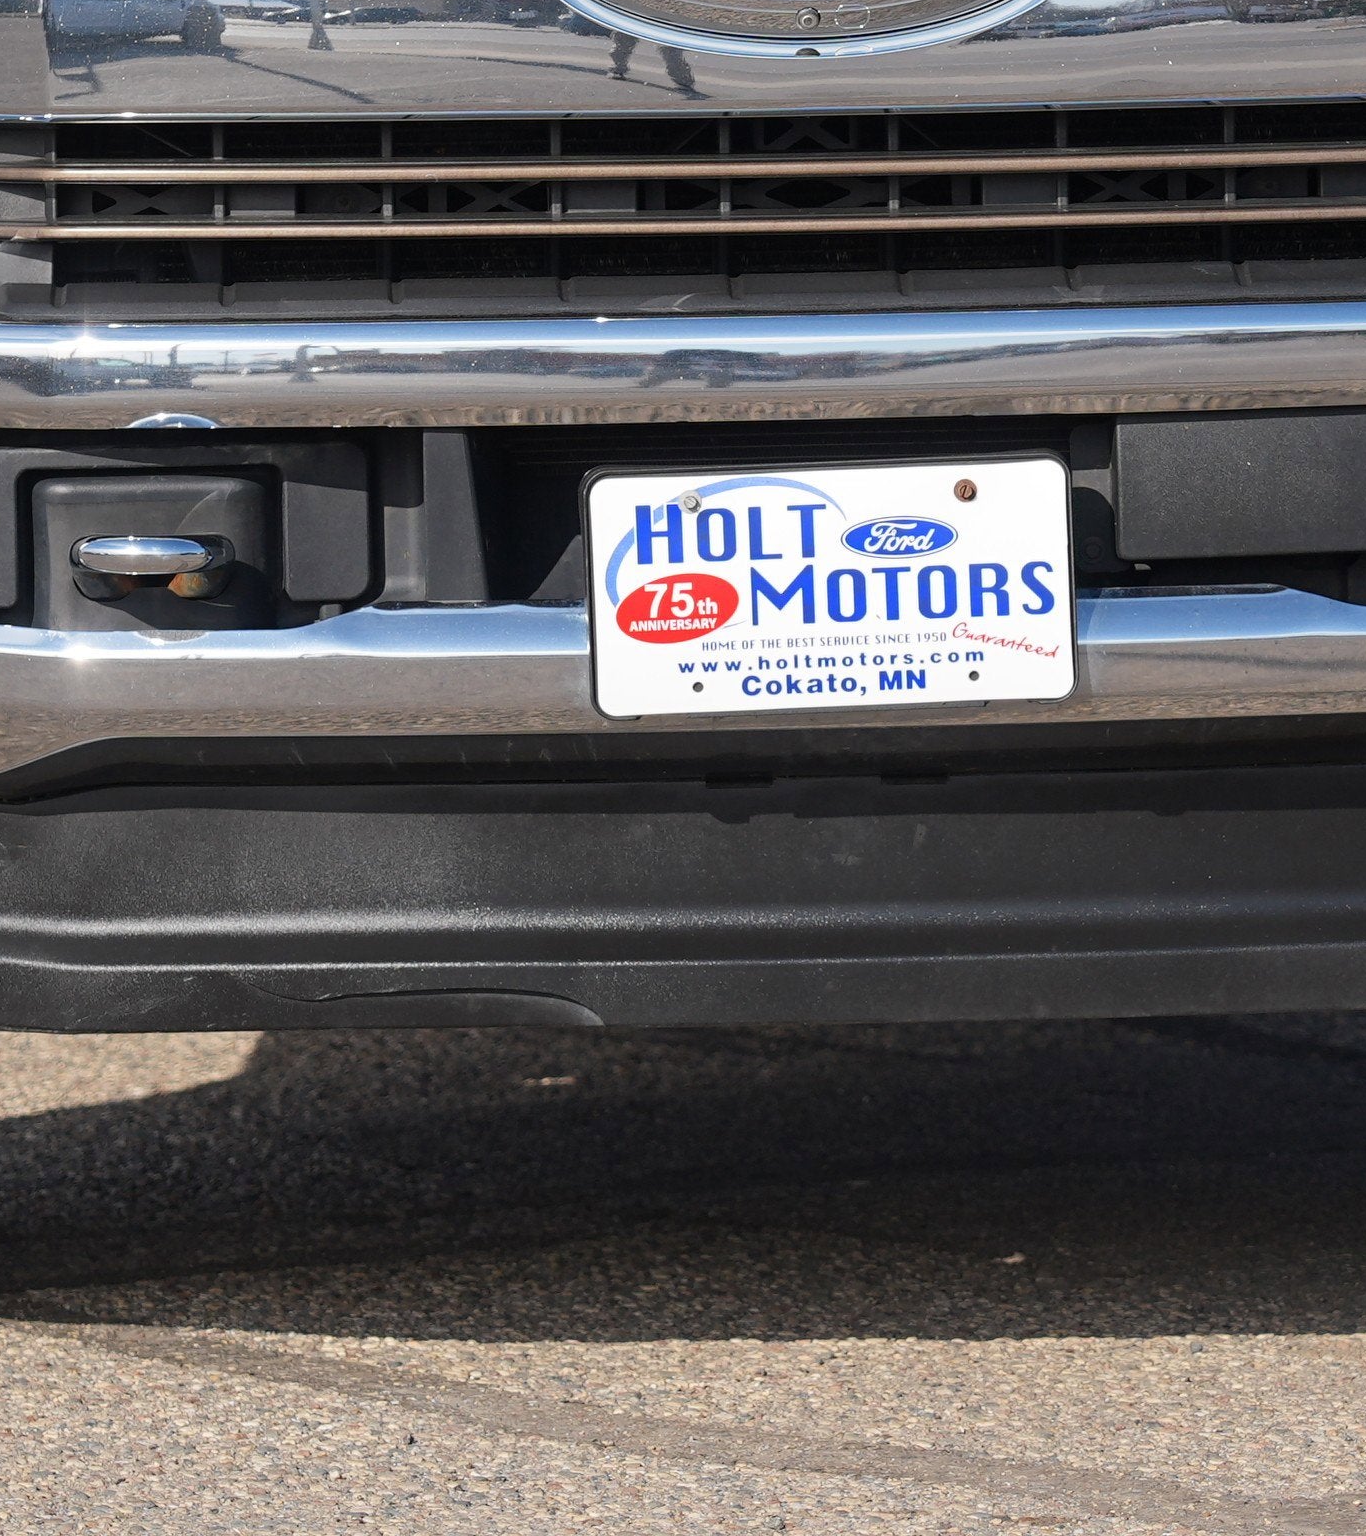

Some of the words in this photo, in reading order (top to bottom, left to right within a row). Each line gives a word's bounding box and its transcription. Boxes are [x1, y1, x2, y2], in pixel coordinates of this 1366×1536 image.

[635, 503, 826, 565] HOLT
[863, 521, 935, 553] Ford
[644, 582, 718, 619] 75th
[750, 560, 1055, 626] MOTORS
[629, 617, 718, 632] ANNIVERSARY
[952, 621, 1060, 659] Guaranteed
[701, 640, 737, 651] HOME
[741, 639, 756, 650] OF
[759, 638, 782, 649] THE
[787, 637, 816, 648] BEST
[820, 634, 871, 647] SERVICE
[875, 633, 911, 644] SINCE
[916, 632, 947, 643] 1950
[678, 650, 984, 673] www.holtmotors.com
[741, 673, 867, 696] Cokato,
[878, 669, 927, 691] MN
